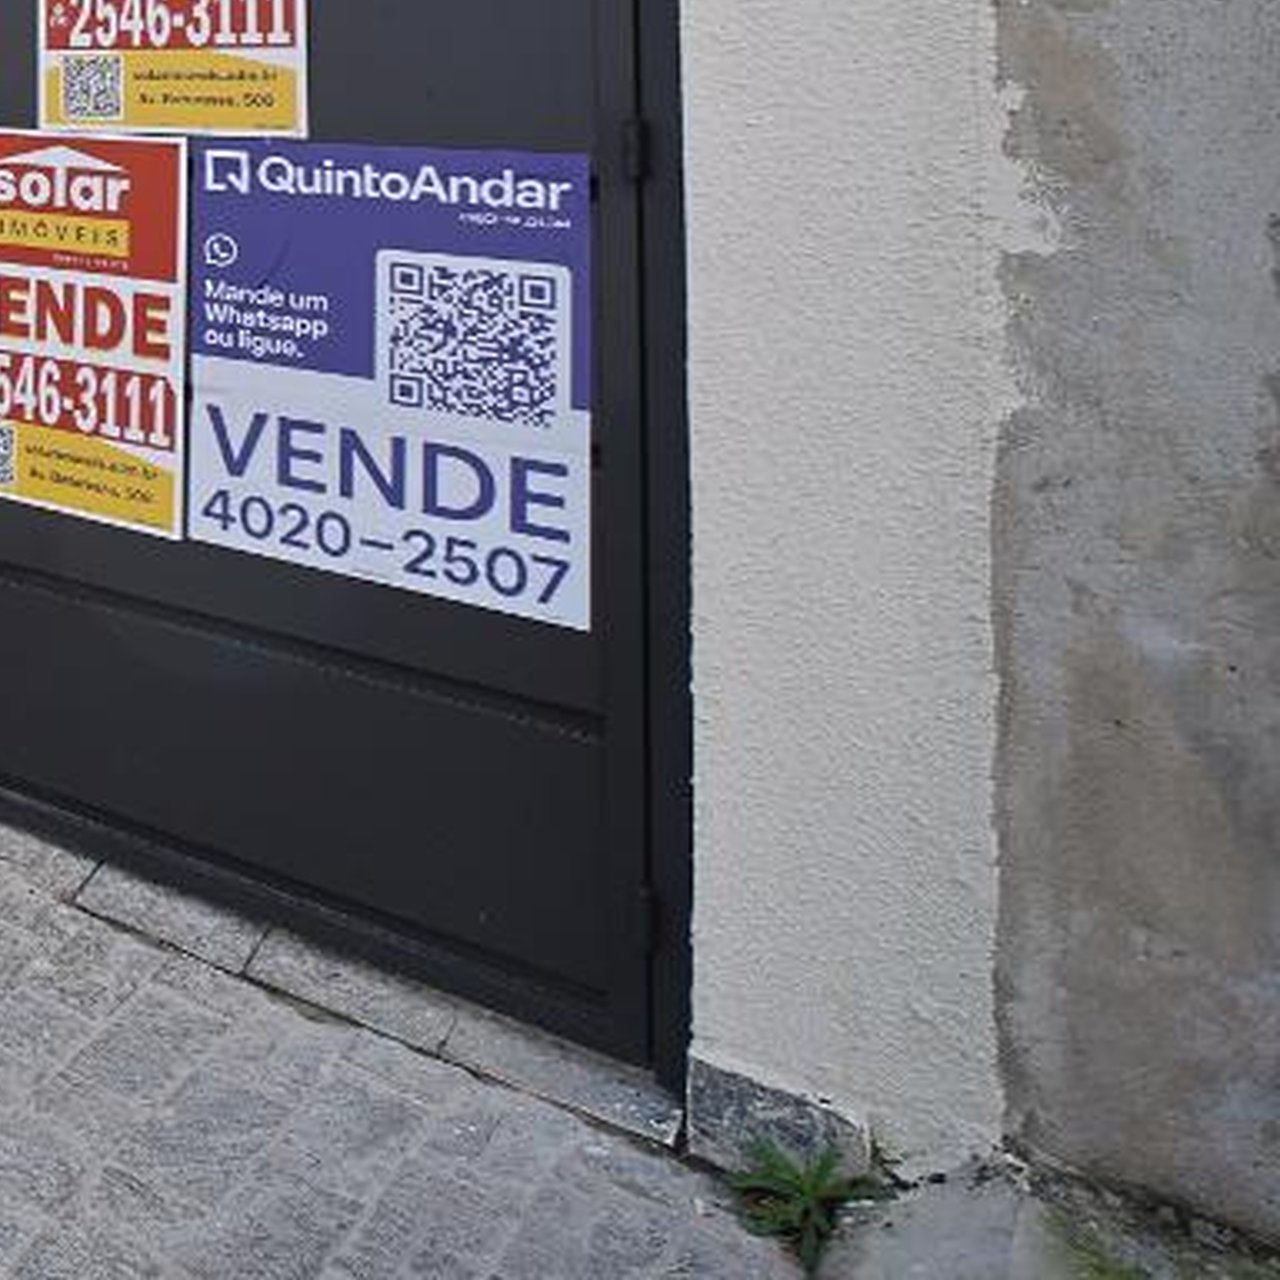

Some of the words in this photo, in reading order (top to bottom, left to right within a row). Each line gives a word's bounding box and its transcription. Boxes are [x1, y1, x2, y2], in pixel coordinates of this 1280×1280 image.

[257, 155, 572, 211] QuintoAndar
[204, 278, 285, 306] Mande
[288, 290, 329, 312] um
[204, 303, 329, 339] Whatsapp
[204, 329, 234, 348] ou
[205, 403, 572, 544] VENDE
[201, 488, 572, 605] 4020-2507
